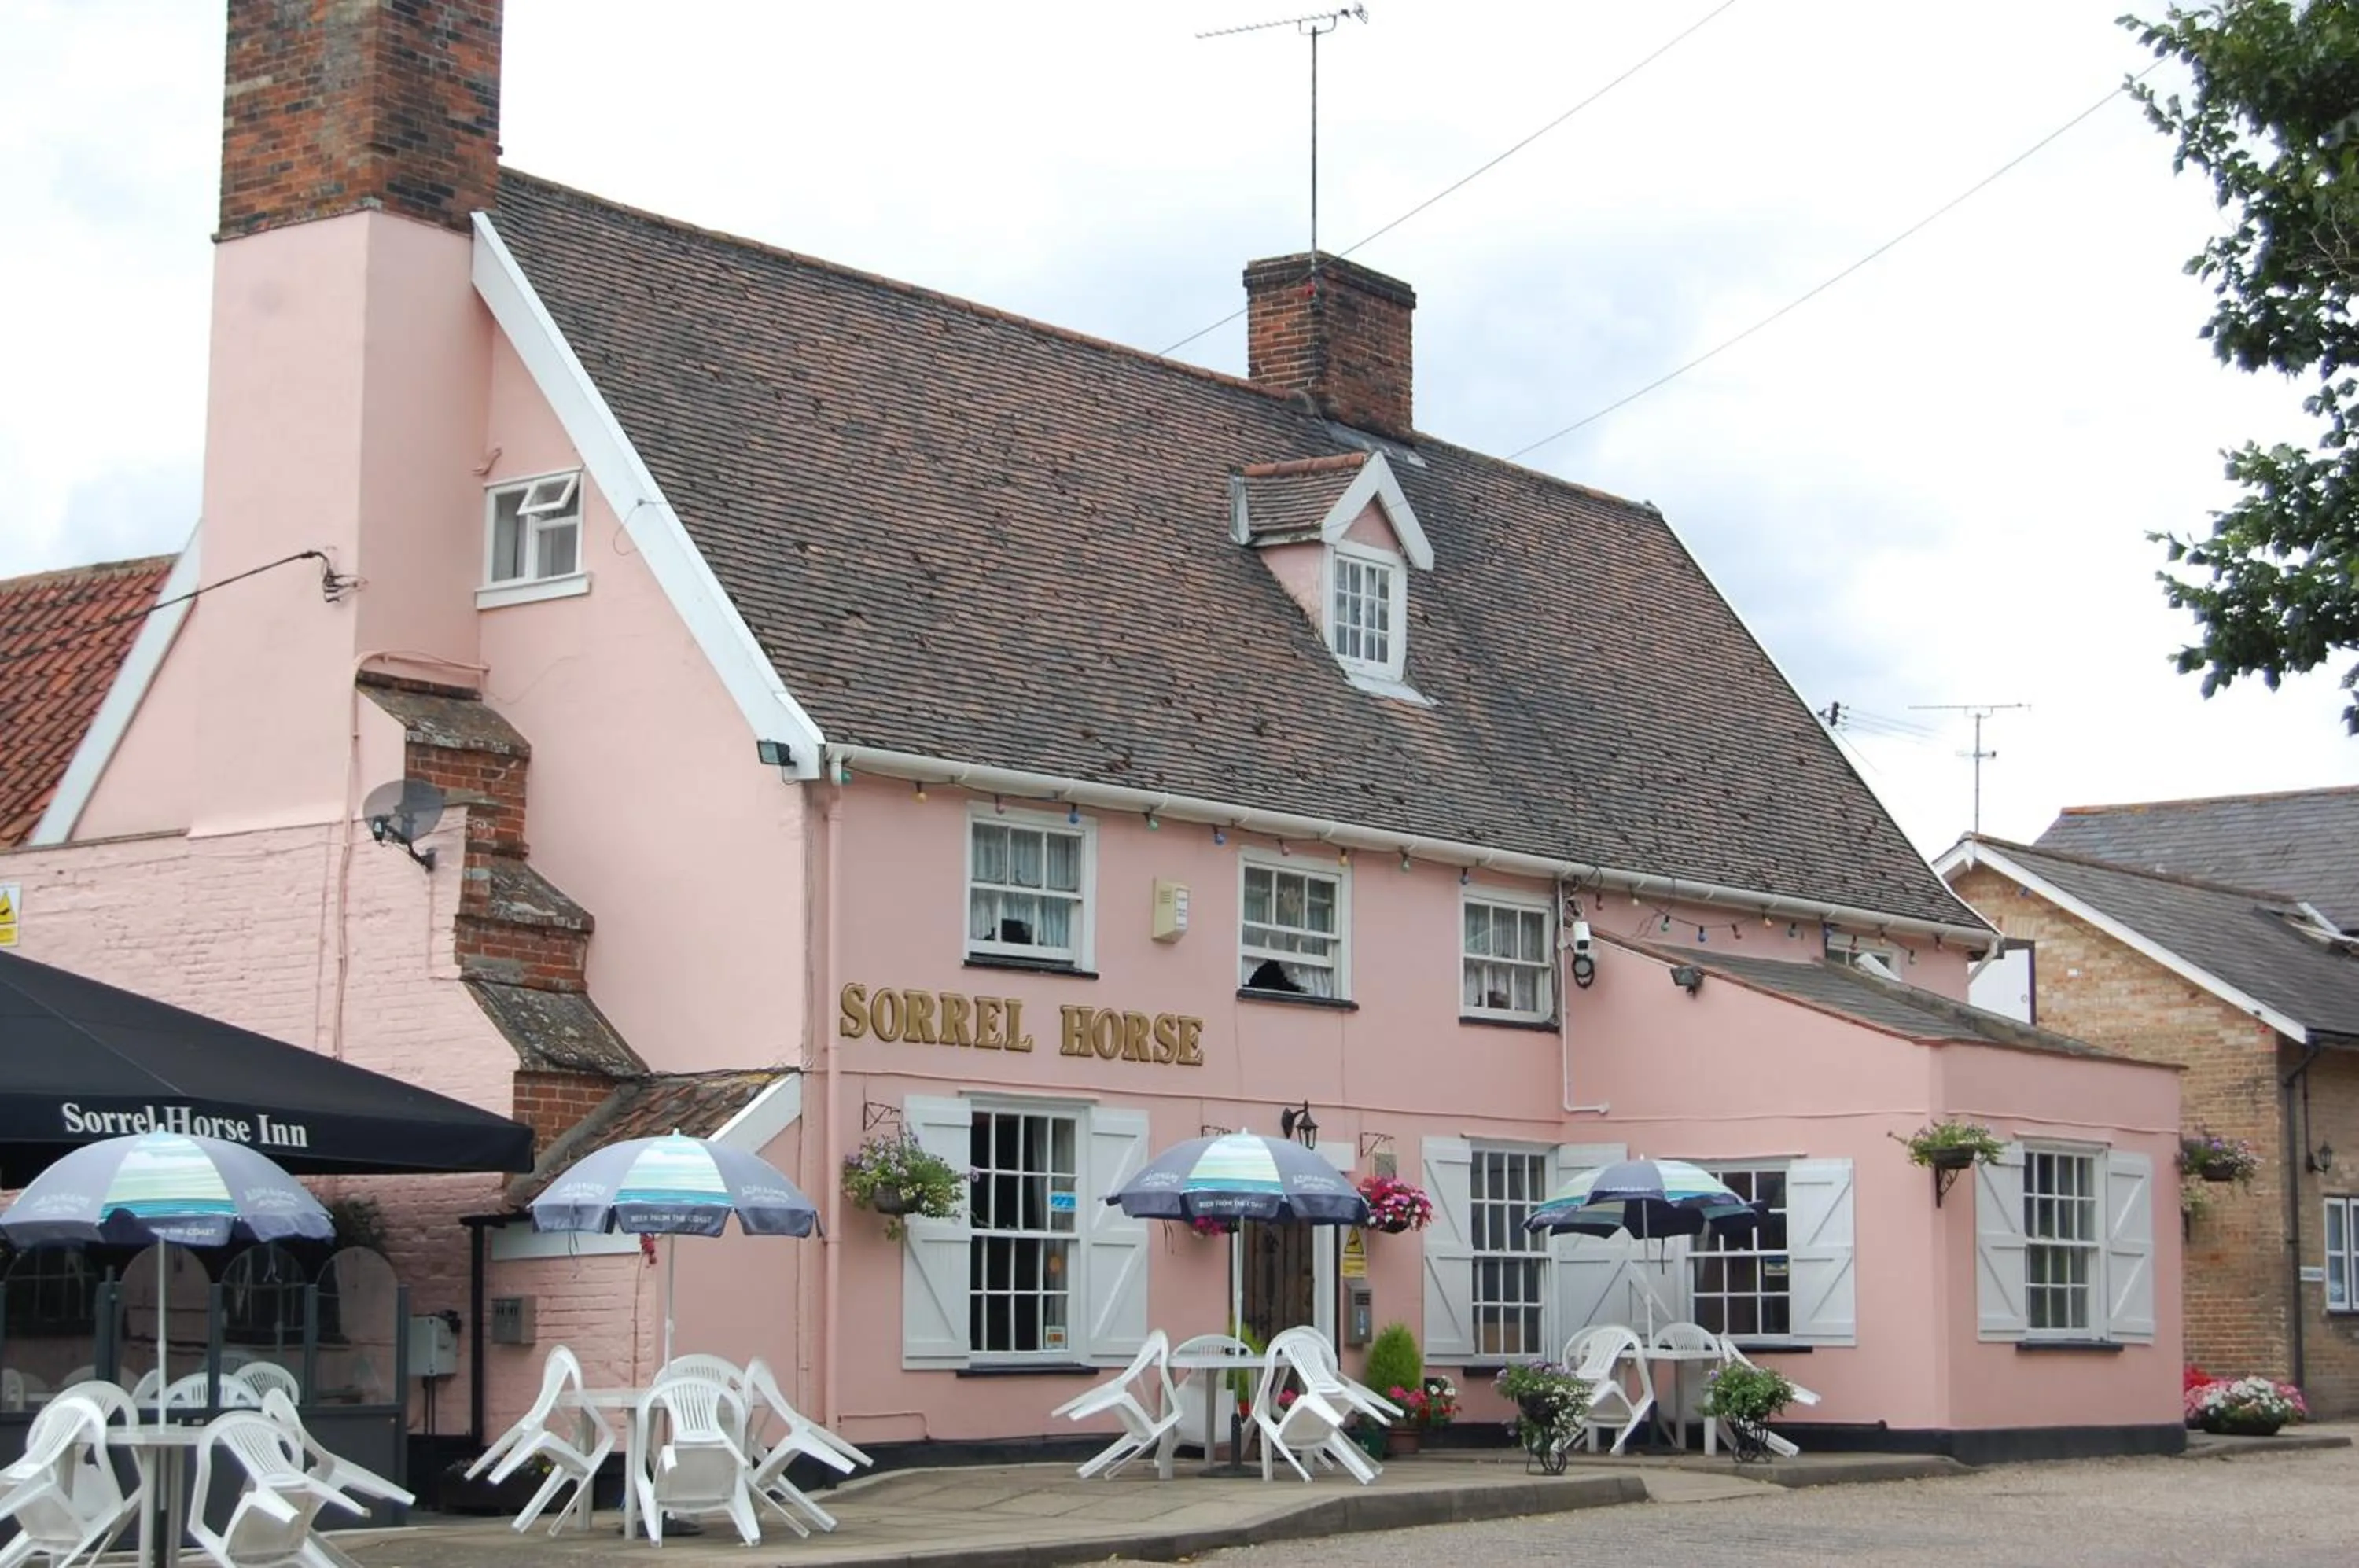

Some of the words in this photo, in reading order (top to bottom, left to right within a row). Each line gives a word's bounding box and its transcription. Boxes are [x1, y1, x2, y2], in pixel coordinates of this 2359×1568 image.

[840, 982, 1033, 1052] SORREL
[1060, 1004, 1203, 1066] HORSE
[62, 1102, 157, 1134] Sorrel
[164, 1106, 252, 1141] Horse
[256, 1113, 309, 1147] Inn
